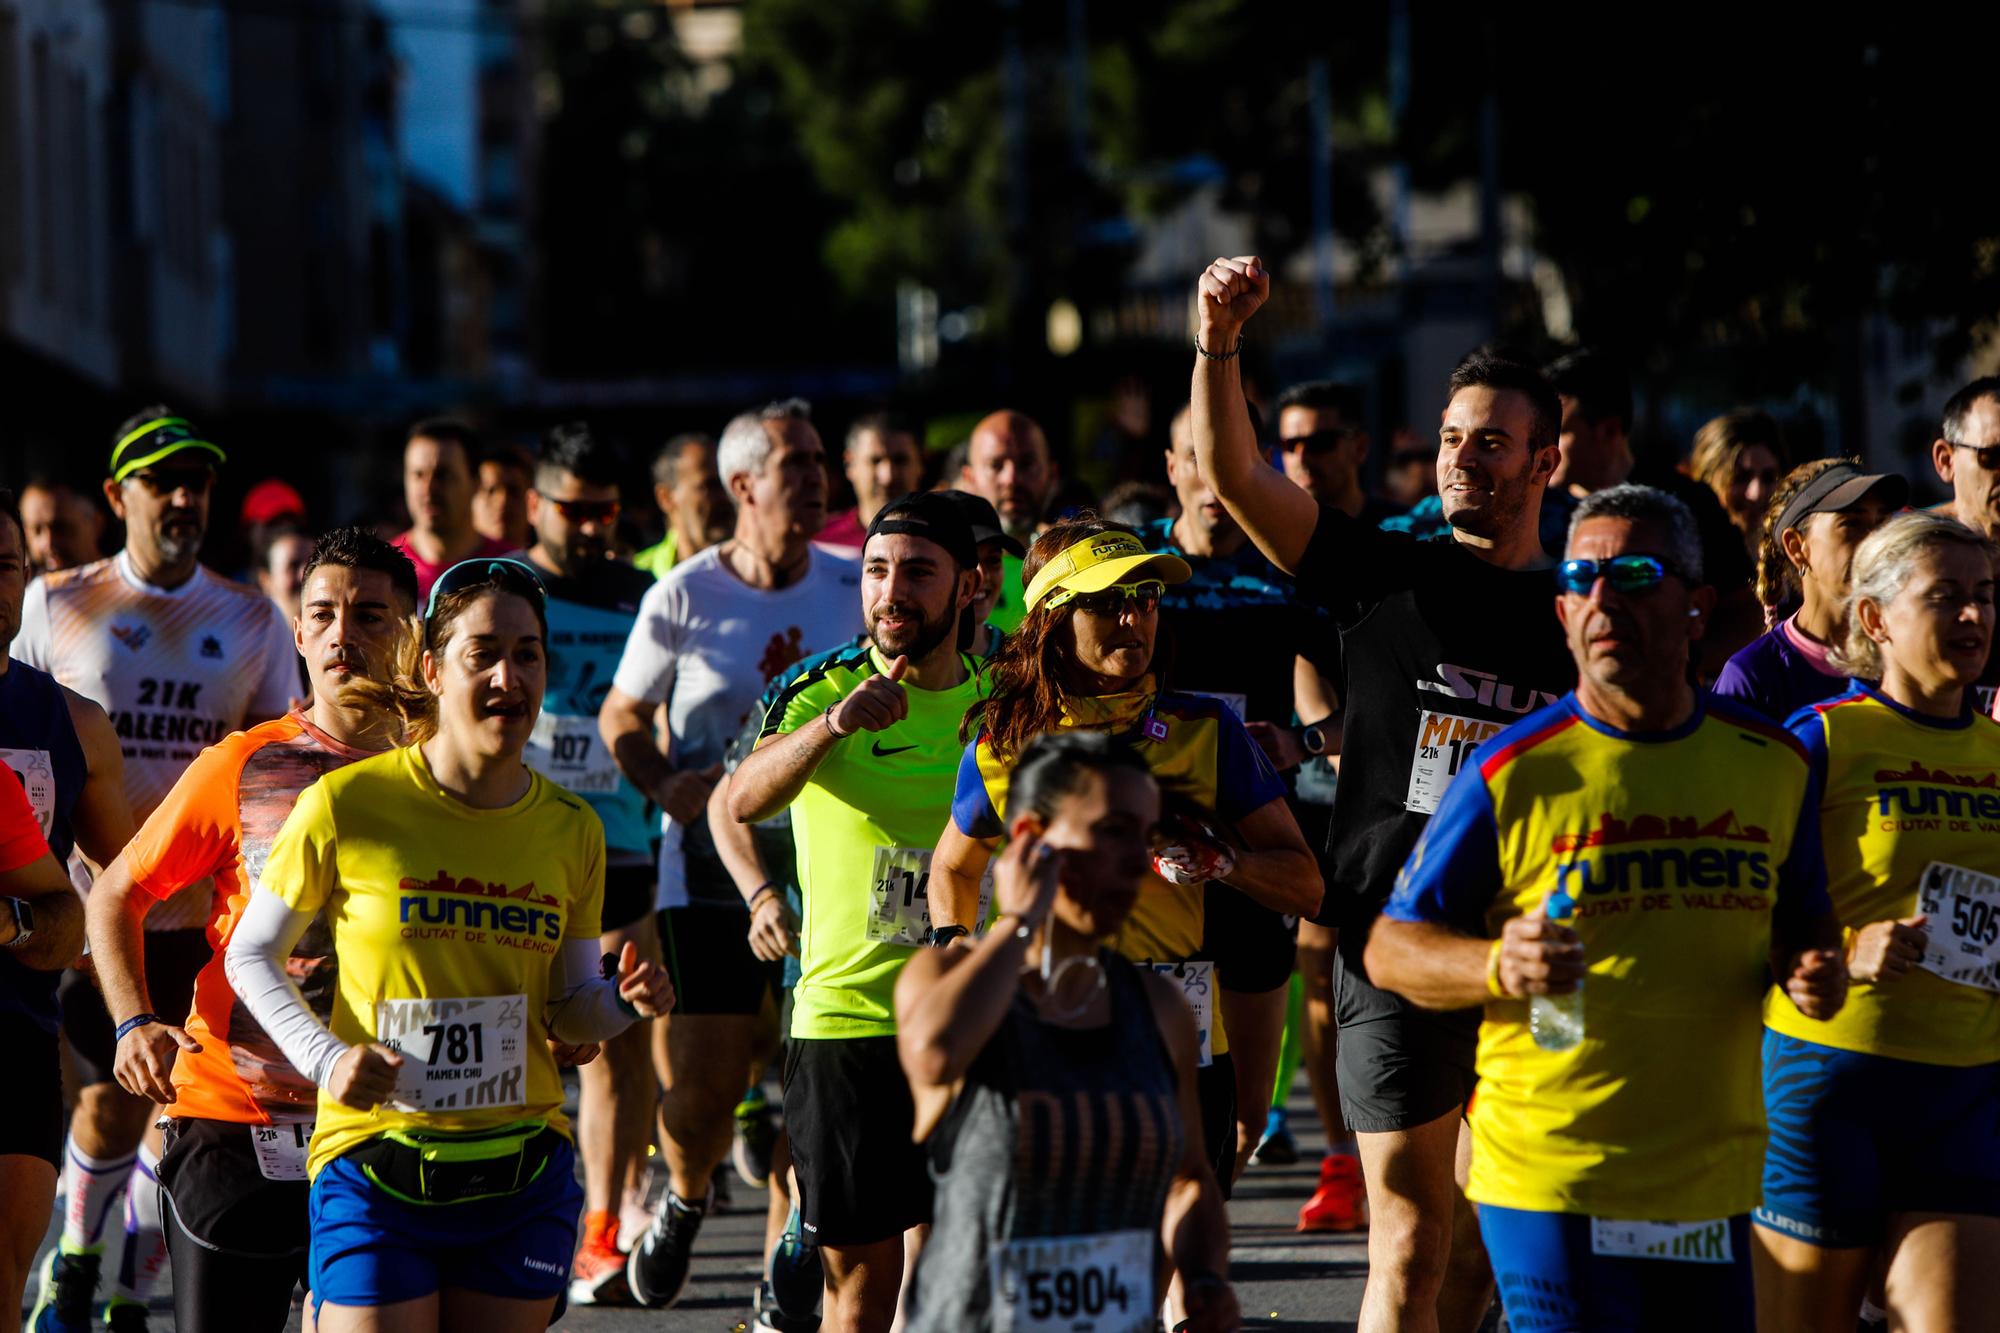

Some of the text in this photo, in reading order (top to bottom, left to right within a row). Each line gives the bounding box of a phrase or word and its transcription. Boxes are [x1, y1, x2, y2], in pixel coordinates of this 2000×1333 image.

[138, 679, 201, 708] 21K
[553, 736, 591, 762] 107
[1881, 820, 1942, 832] CIUTAT
[1949, 821, 1971, 832] DE
[1556, 847, 1770, 893] runners
[400, 896, 560, 940] runners
[1576, 899, 1636, 918] UTAT
[1640, 895, 1671, 910] DE
[400, 927, 458, 941] CIUTAT
[465, 931, 487, 944] DE
[423, 1023, 483, 1066] 781
[426, 1068, 482, 1081] MAMEN CHU
[258, 1130, 278, 1142] 21k
[1755, 1205, 1842, 1242] LURBE
[1027, 1264, 1127, 1319] 5904
